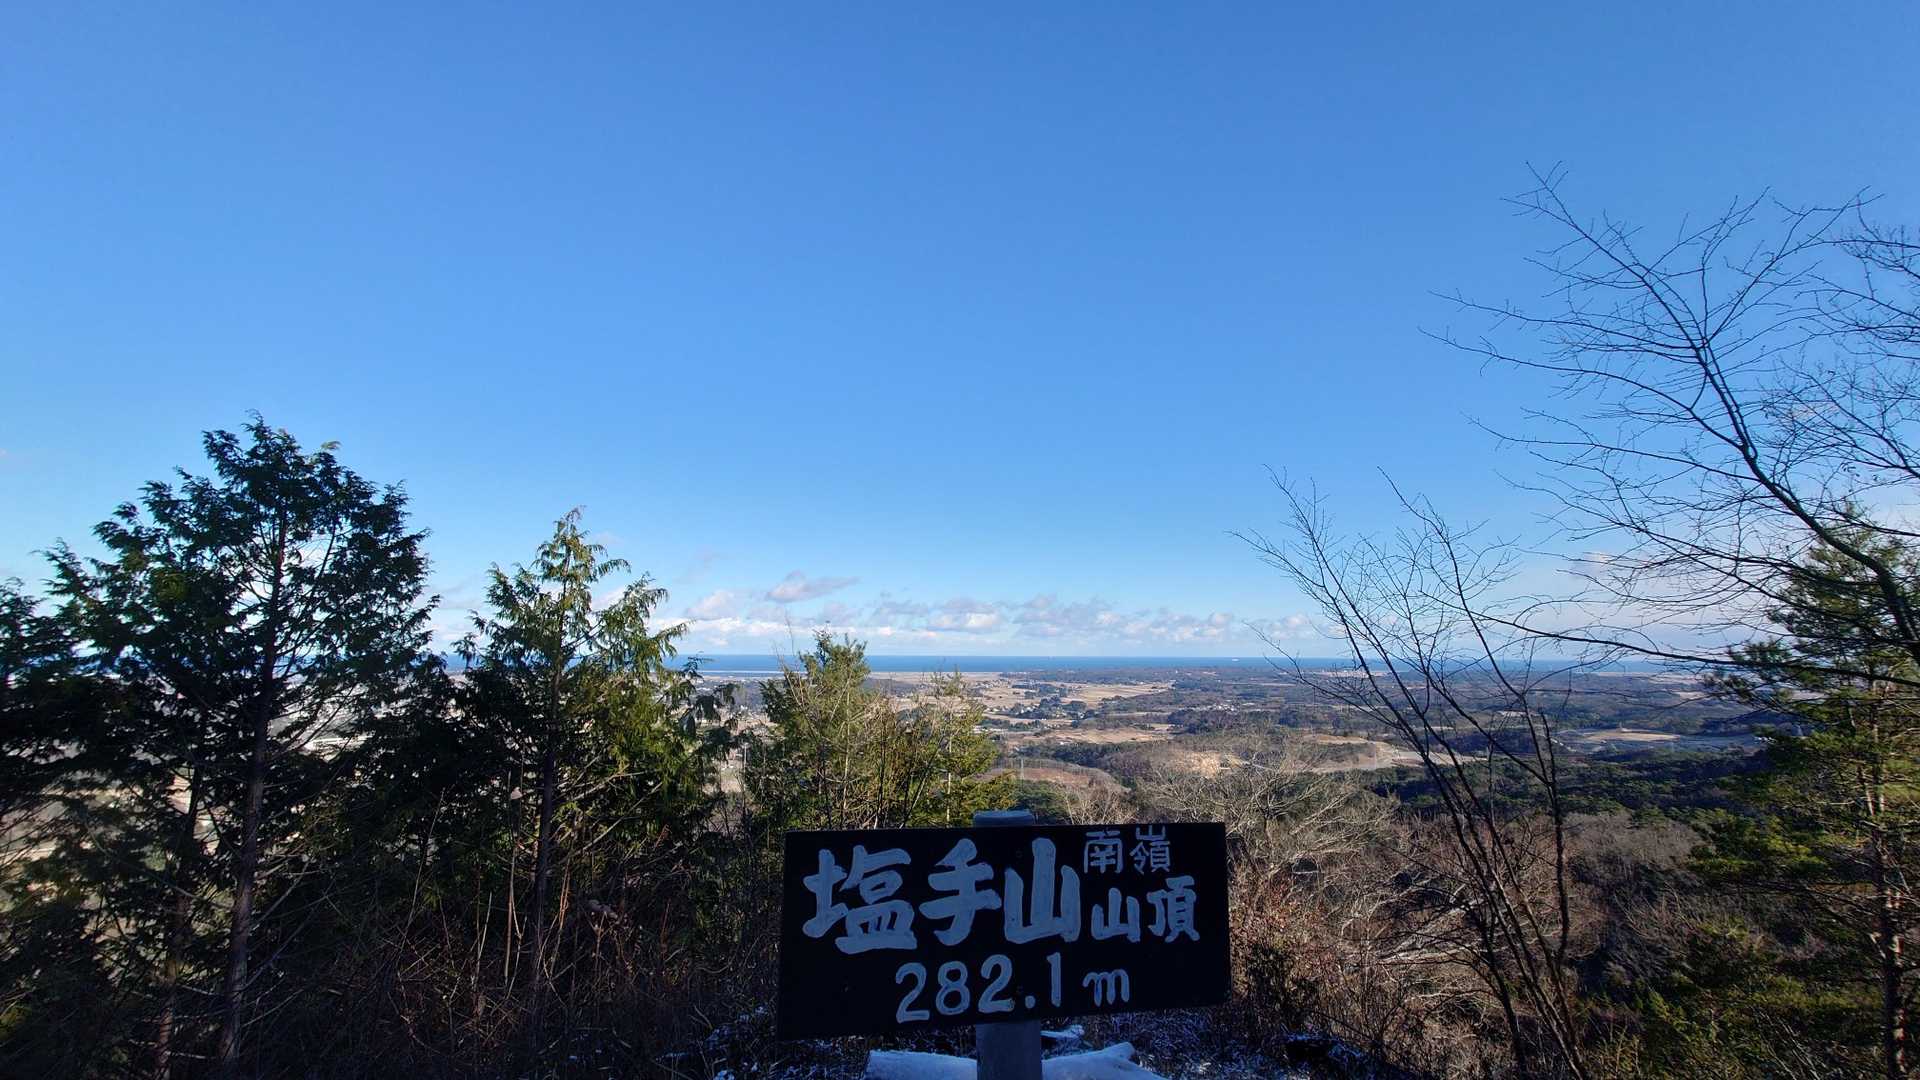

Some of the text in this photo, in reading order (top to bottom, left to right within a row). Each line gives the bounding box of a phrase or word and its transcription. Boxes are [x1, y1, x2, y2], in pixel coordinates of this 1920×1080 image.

[803, 837, 1081, 955] 塩手山
[1091, 875, 1201, 943] 山頂
